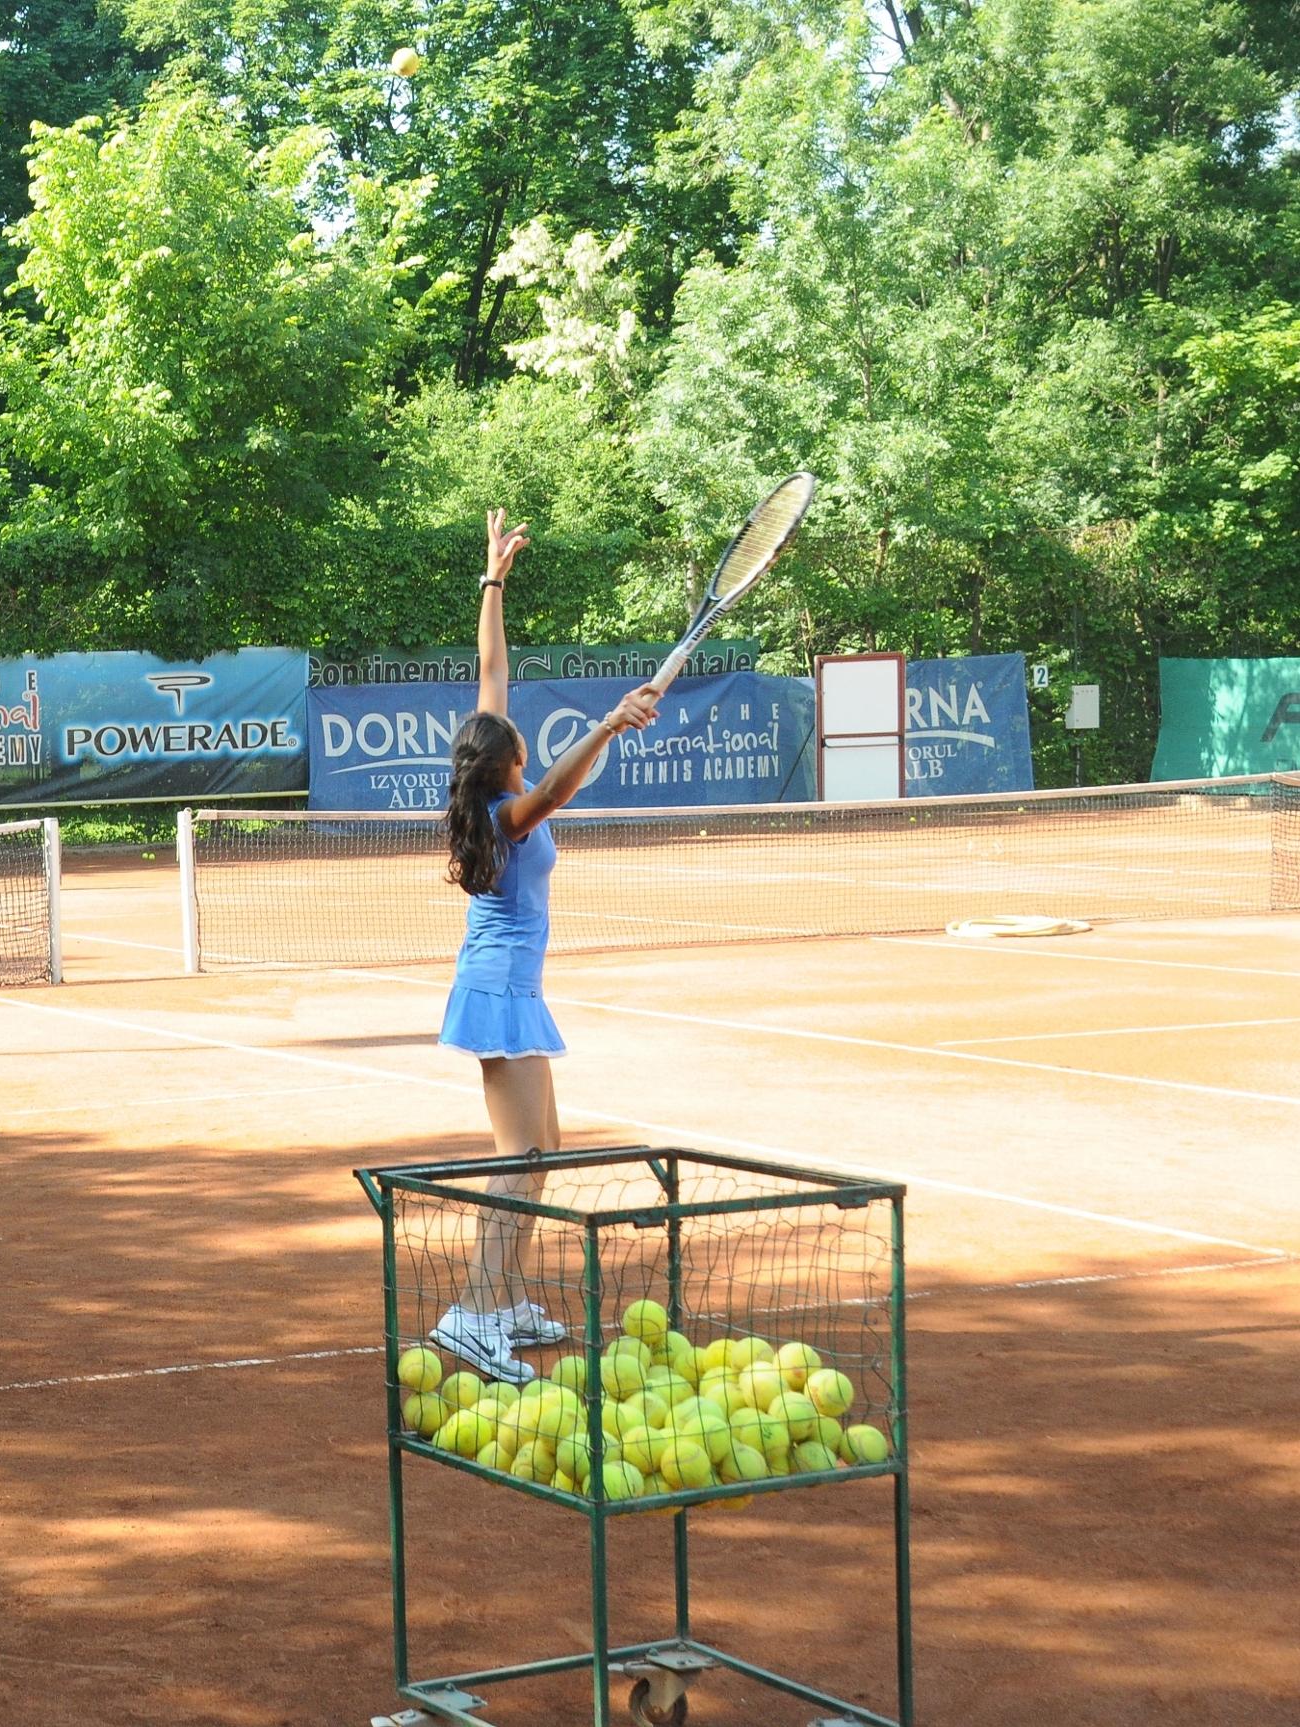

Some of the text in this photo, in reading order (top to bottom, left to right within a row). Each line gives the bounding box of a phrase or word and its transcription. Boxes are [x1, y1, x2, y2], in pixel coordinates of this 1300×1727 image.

[561, 647, 752, 678] Continntale
[1036, 667, 1046, 685] 2
[905, 683, 991, 729] RNA
[67, 720, 288, 757] POWERADE
[321, 711, 458, 757] DORN
[617, 722, 779, 760] International
[905, 744, 957, 761] ORUL
[620, 755, 780, 786] TENNIS ACADEMY
[388, 787, 441, 810] ALB
